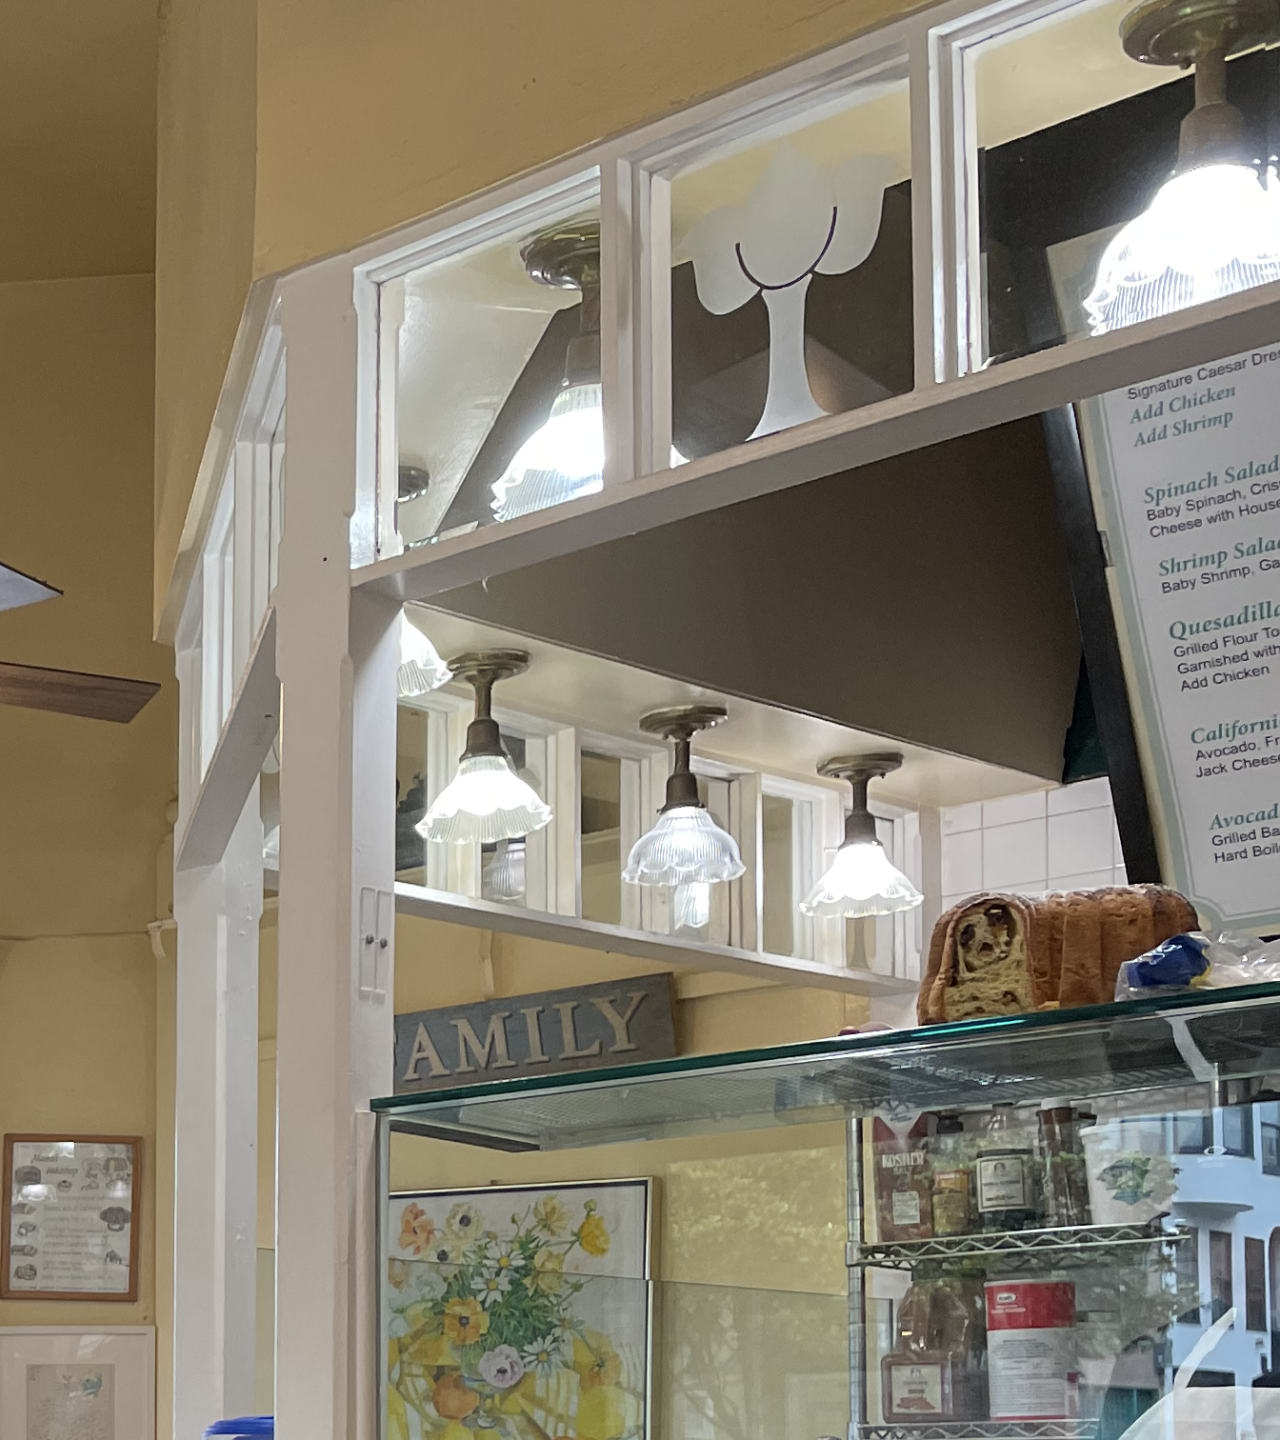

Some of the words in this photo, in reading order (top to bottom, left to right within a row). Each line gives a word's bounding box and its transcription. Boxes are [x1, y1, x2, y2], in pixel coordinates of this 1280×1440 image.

[1128, 374, 1193, 400] Signature
[1197, 359, 1248, 381] Caesar
[1130, 401, 1164, 424] Add
[1169, 387, 1236, 413] Chicken
[1133, 424, 1168, 448] Add
[1172, 411, 1234, 437] Shrimp
[1144, 471, 1218, 507] Spinach
[1224, 454, 1280, 484] Salad
[1147, 503, 1181, 521] Baby
[1250, 480, 1280, 496] Cris
[1149, 518, 1203, 538] Cheese
[1206, 509, 1235, 525] with
[1159, 550, 1228, 577] Shrimp
[1162, 578, 1196, 594] Baby
[1174, 638, 1219, 658] Grilled
[1222, 631, 1258, 648] Flour
[1177, 650, 1249, 674] Garnished
[1253, 643, 1280, 658] with
[1181, 676, 1209, 692] Add
[1212, 665, 1270, 685] Chicken
[1190, 713, 1280, 744] Californi
[1195, 762, 1228, 778] Jack
[1211, 828, 1257, 847] Grilled
[1214, 847, 1248, 864] Hard
[1252, 842, 1280, 858] Boil
[393, 990, 649, 1082] AMILY
[881, 1151, 925, 1169] KOSHER
